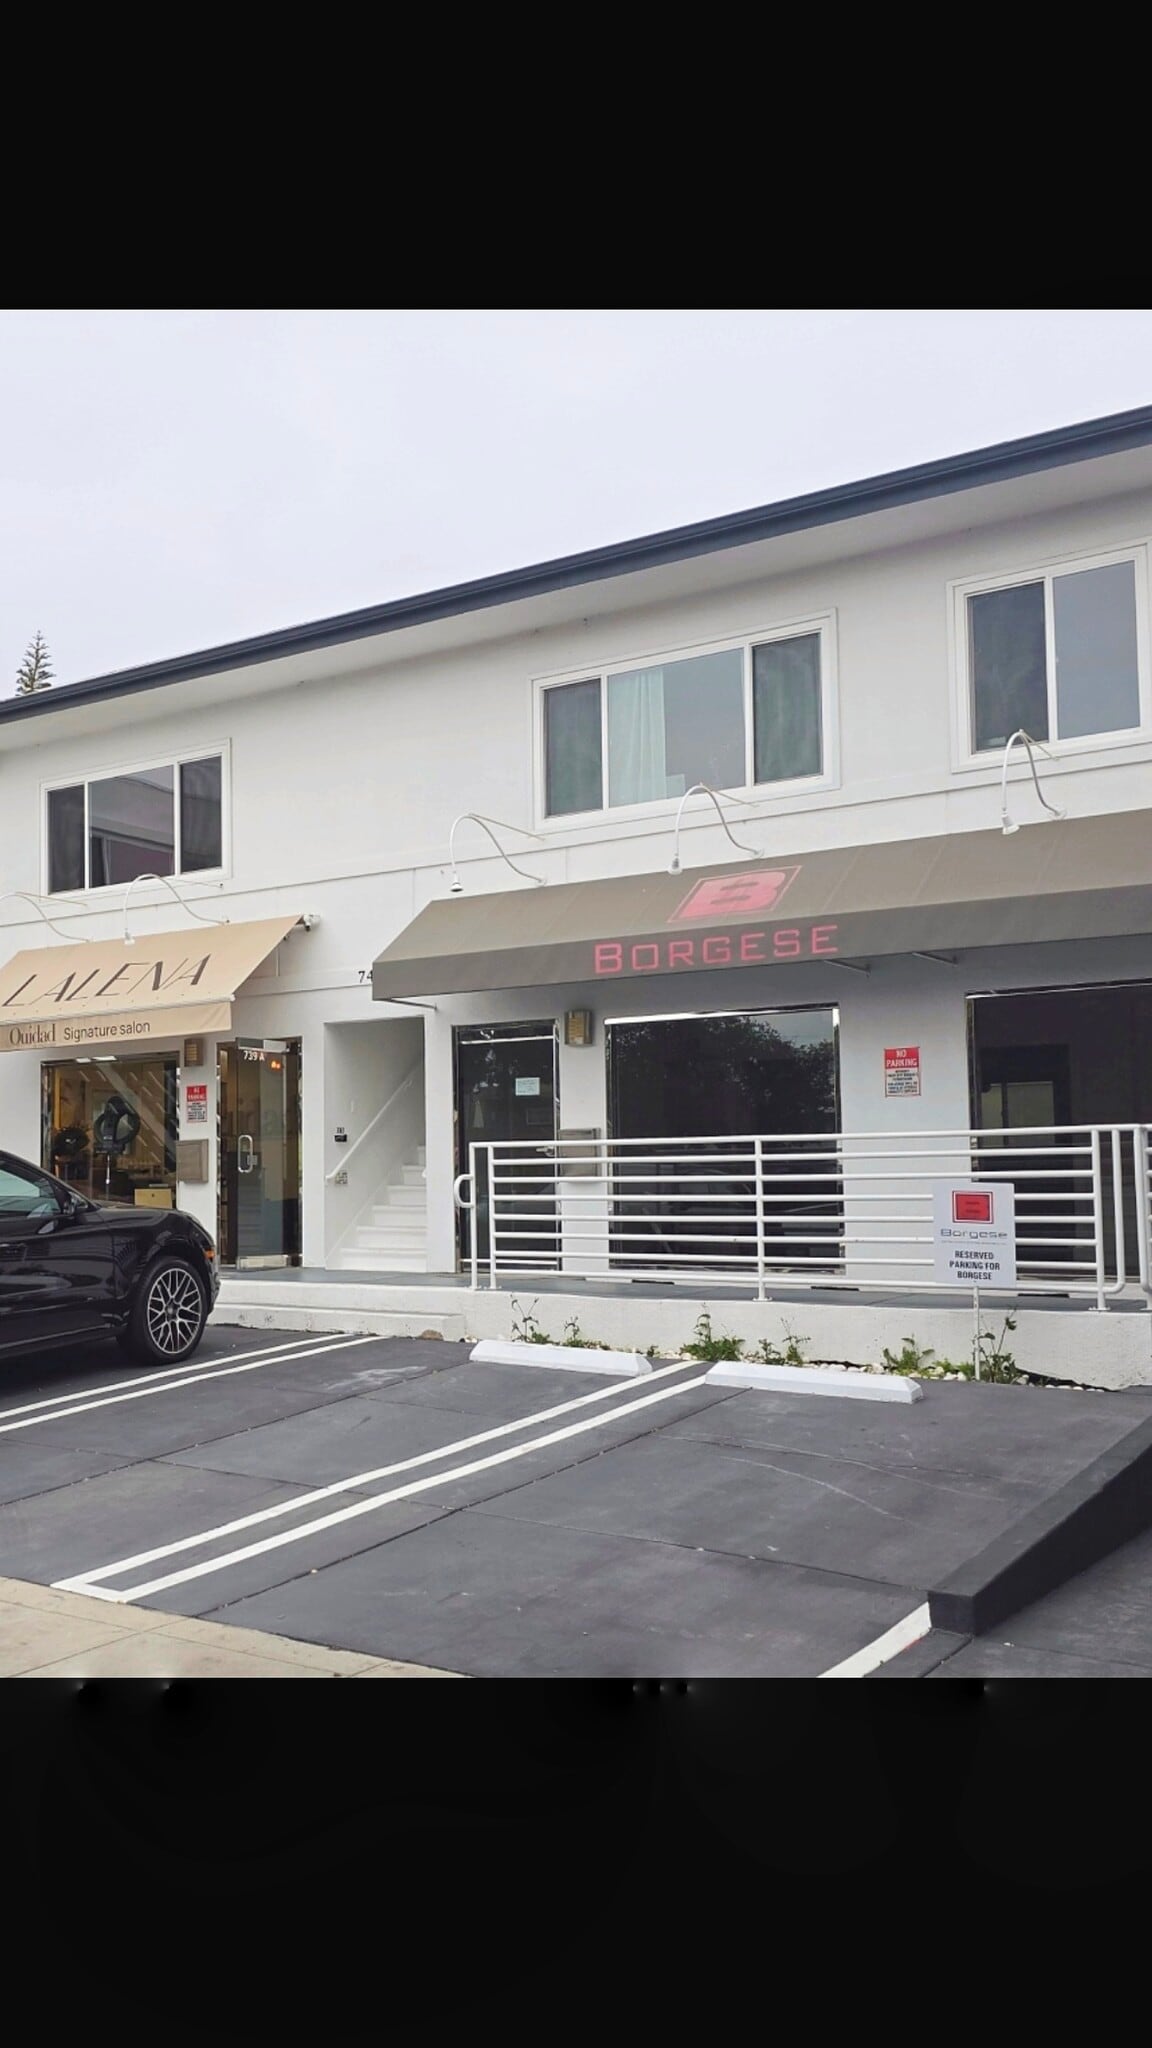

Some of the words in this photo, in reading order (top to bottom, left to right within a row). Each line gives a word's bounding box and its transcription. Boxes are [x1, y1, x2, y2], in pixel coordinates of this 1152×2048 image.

[594, 924, 839, 974] BORGESE
[1, 953, 212, 1007] LALENA
[63, 1025, 118, 1043] Signature
[119, 1020, 151, 1035] salon
[243, 1050, 258, 1061] 739
[895, 1049, 907, 1058] NO
[886, 1058, 918, 1067] PARKING
[940, 1228, 1008, 1239] Borgese
[954, 1250, 994, 1260] RESERVED
[949, 1260, 984, 1270] PARKING
[985, 1262, 1000, 1270] FOR
[957, 1270, 992, 1280] BORGESE
